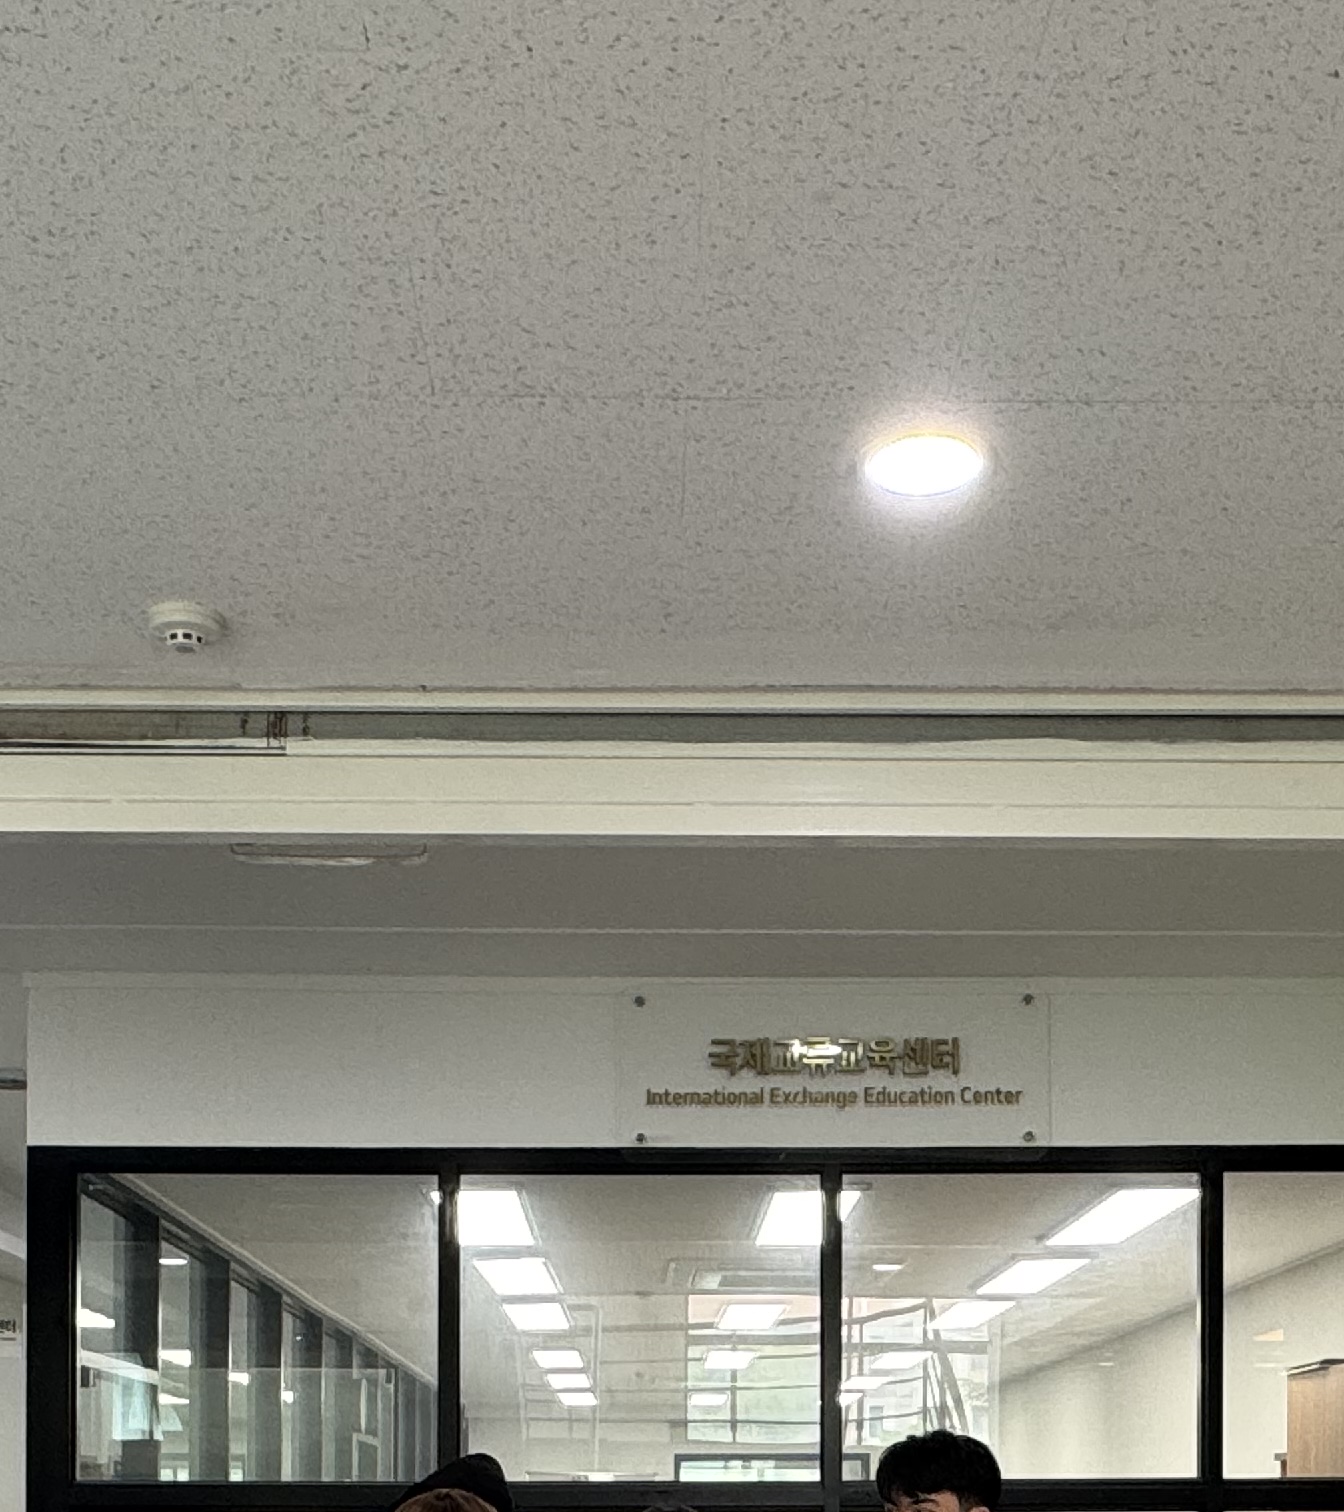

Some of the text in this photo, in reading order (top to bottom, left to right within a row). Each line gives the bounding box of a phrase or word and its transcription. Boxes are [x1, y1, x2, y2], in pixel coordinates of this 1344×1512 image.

[708, 1036, 960, 1077] 국제교류교육센터
[646, 1087, 1023, 1111] International Exchange Education Center
